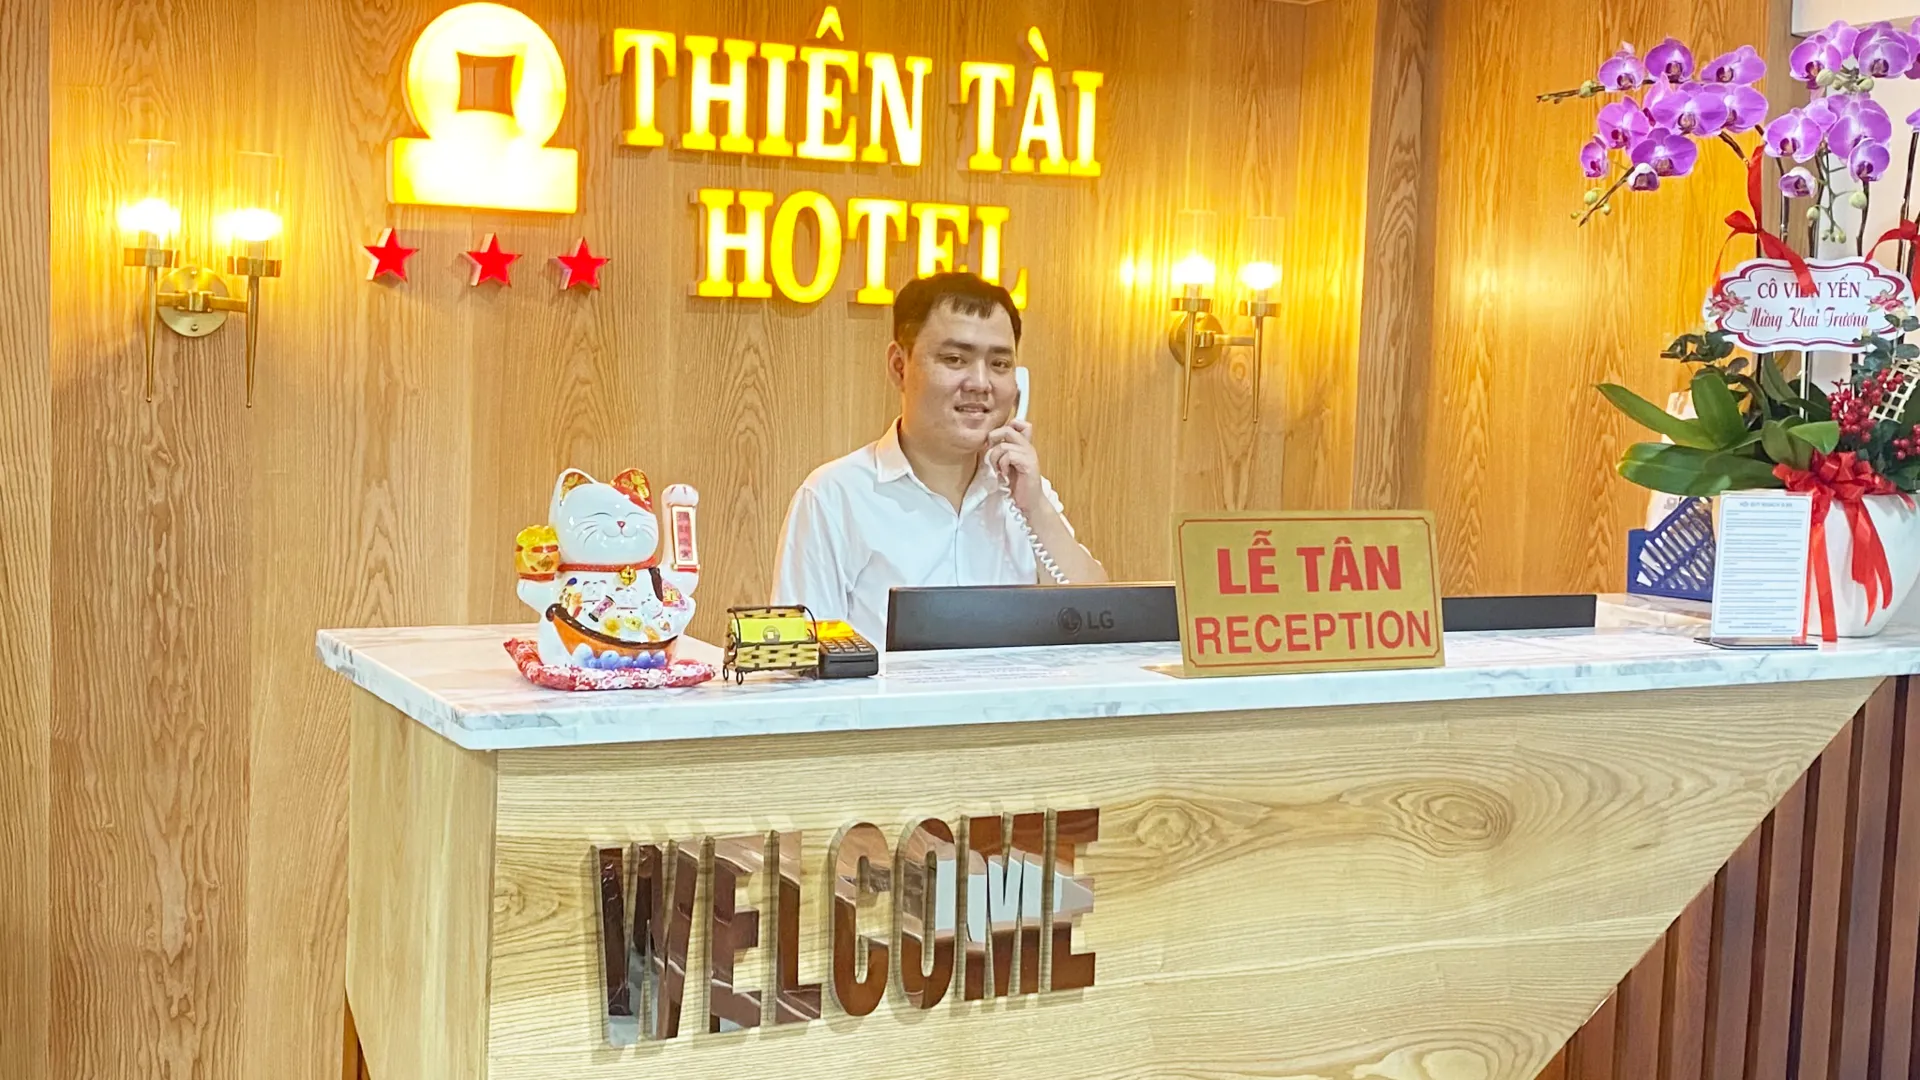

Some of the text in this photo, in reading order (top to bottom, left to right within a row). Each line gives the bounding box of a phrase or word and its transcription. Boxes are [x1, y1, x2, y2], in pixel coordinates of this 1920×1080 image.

[613, 5, 1104, 177] THIÊN TÀI
[698, 189, 1027, 310] HOTEL
[1757, 273, 1861, 299] CÔ VIN YẾN
[1786, 307, 1820, 328] Khai
[1217, 530, 1401, 594] LỄ TÂN
[1088, 611, 1114, 629] LG
[1195, 610, 1431, 655] RECEPTION
[590, 788, 1099, 1047] WELCOME
